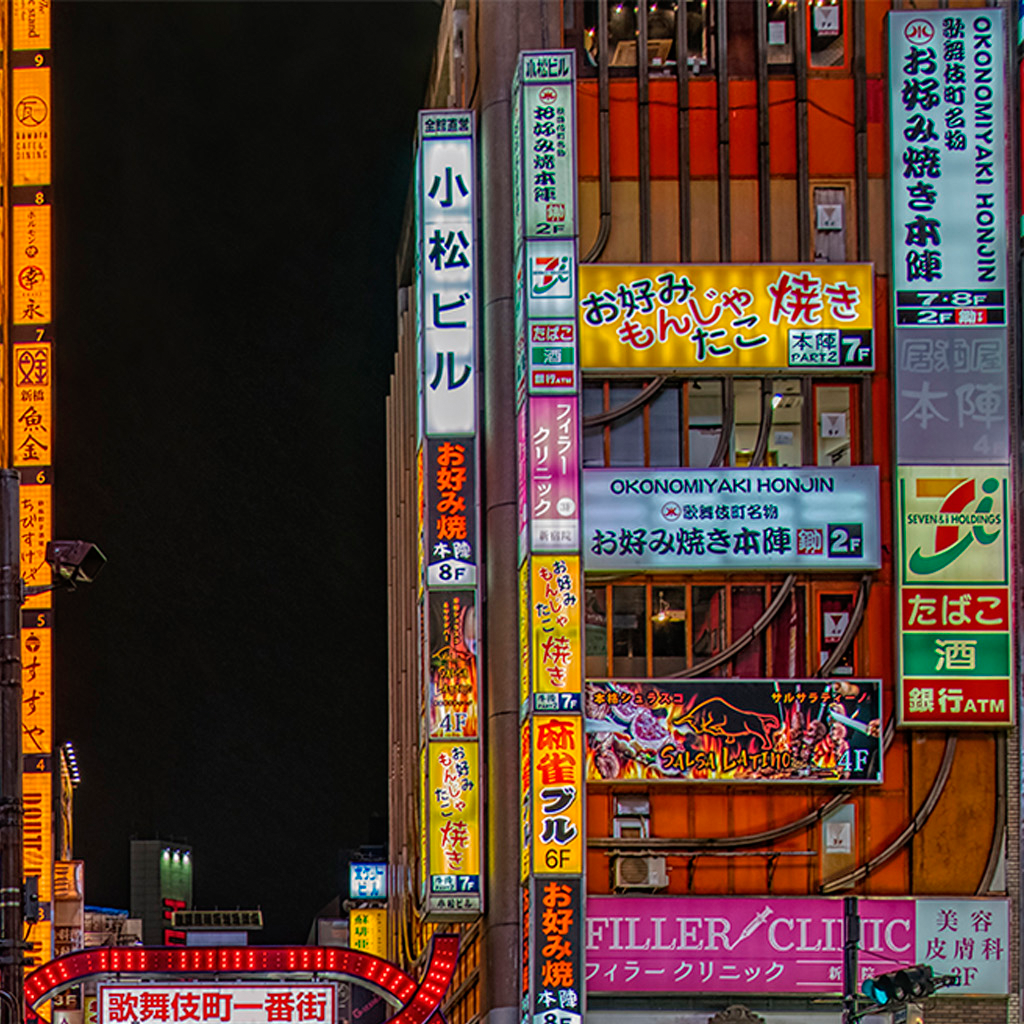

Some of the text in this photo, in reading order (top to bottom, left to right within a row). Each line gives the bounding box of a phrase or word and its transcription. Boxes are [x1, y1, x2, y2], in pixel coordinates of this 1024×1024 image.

[34, 54, 43, 67] 9
[526, 57, 570, 78] 小松ビル
[943, 17, 967, 151] 歌舞伎町名物
[902, 46, 942, 282] お好み焼き本陣
[973, 16, 996, 282] OKONOMIYAKI HONJIN
[35, 191, 44, 205] 8
[536, 223, 565, 235] 2F
[428, 167, 472, 391] 小松ビル
[581, 273, 694, 325] お好み
[768, 271, 860, 324] 焼き
[619, 289, 752, 349] もんじゃ
[917, 311, 953, 323] 2F
[36, 329, 45, 342] 7
[533, 326, 573, 341] たばこ
[691, 316, 767, 361] たこ
[792, 332, 869, 363] 本陣 7F
[543, 348, 562, 363] 酒
[902, 381, 1004, 430] 本陣
[18, 406, 48, 461] 魚金
[556, 404, 571, 475] フィラー
[36, 471, 45, 484] 6
[534, 426, 552, 517] クリニック
[610, 477, 834, 494] OKONOMIYAKI HONJIN
[436, 441, 467, 540] お好み焼
[683, 504, 779, 520] 歌舞伎町名物
[951, 514, 1002, 525] HOLDINGS
[432, 541, 472, 559] 本陣
[591, 527, 792, 556] お好み焼き本陣
[830, 528, 860, 552] 2F
[439, 565, 466, 581] 8F
[553, 560, 576, 606] お好み
[908, 594, 1003, 625] たばこ
[542, 636, 571, 687] 焼き
[935, 639, 977, 671] 酒
[22, 656, 45, 750] すずや
[439, 713, 467, 733] 4F
[36, 759, 45, 771] 4
[452, 746, 474, 792] お好み
[838, 750, 868, 771] 4F
[440, 820, 470, 871] 焼き
[546, 849, 571, 869] 6F
[459, 876, 475, 891] 7F
[542, 882, 574, 987] お好み焼
[585, 917, 734, 951] FILLER
[937, 910, 993, 932] 美容
[926, 938, 1004, 960] 皮膚科
[53, 994, 77, 1006] 3F
[108, 990, 328, 1023] 歌舞伎町一番街
[537, 990, 578, 1008] 本陣
